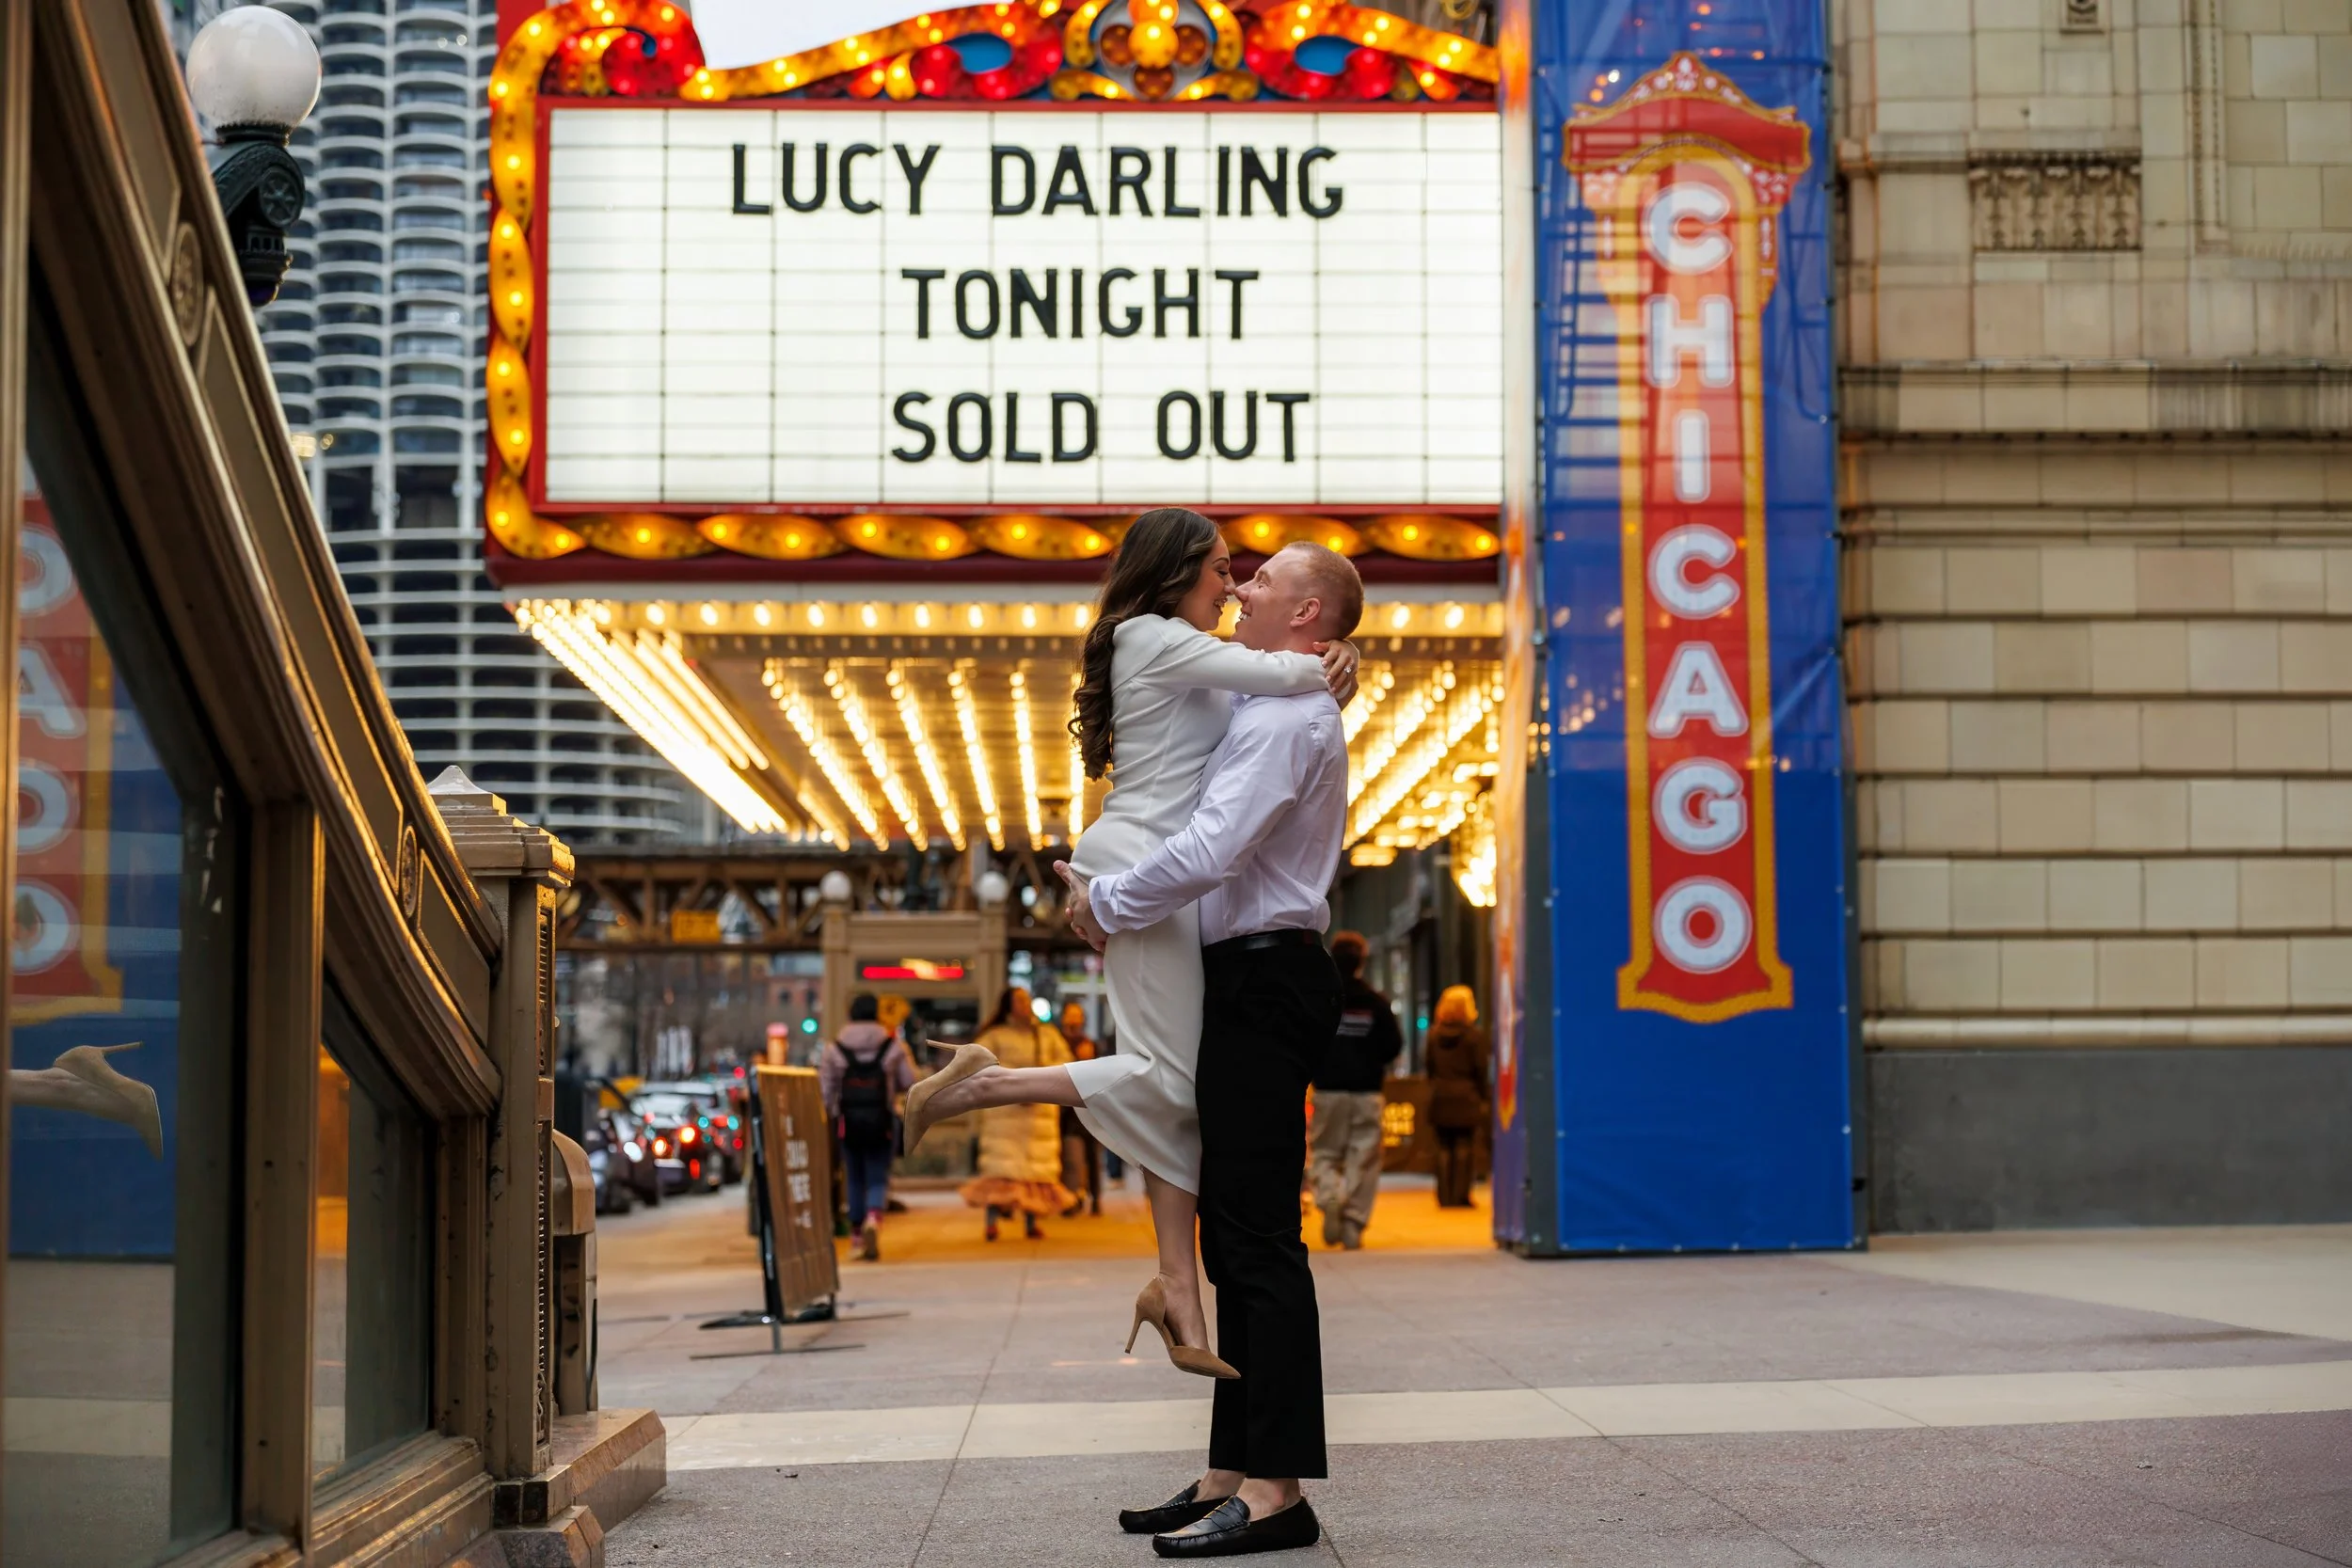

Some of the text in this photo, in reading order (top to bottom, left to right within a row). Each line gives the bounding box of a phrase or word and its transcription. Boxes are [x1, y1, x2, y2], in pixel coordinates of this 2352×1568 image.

[733, 143, 1343, 219] LUCY DARLING
[902, 268, 1259, 340] TONIGHT
[892, 391, 1310, 463] SOLD OUT
[1642, 182, 1753, 975] CHICAGO
